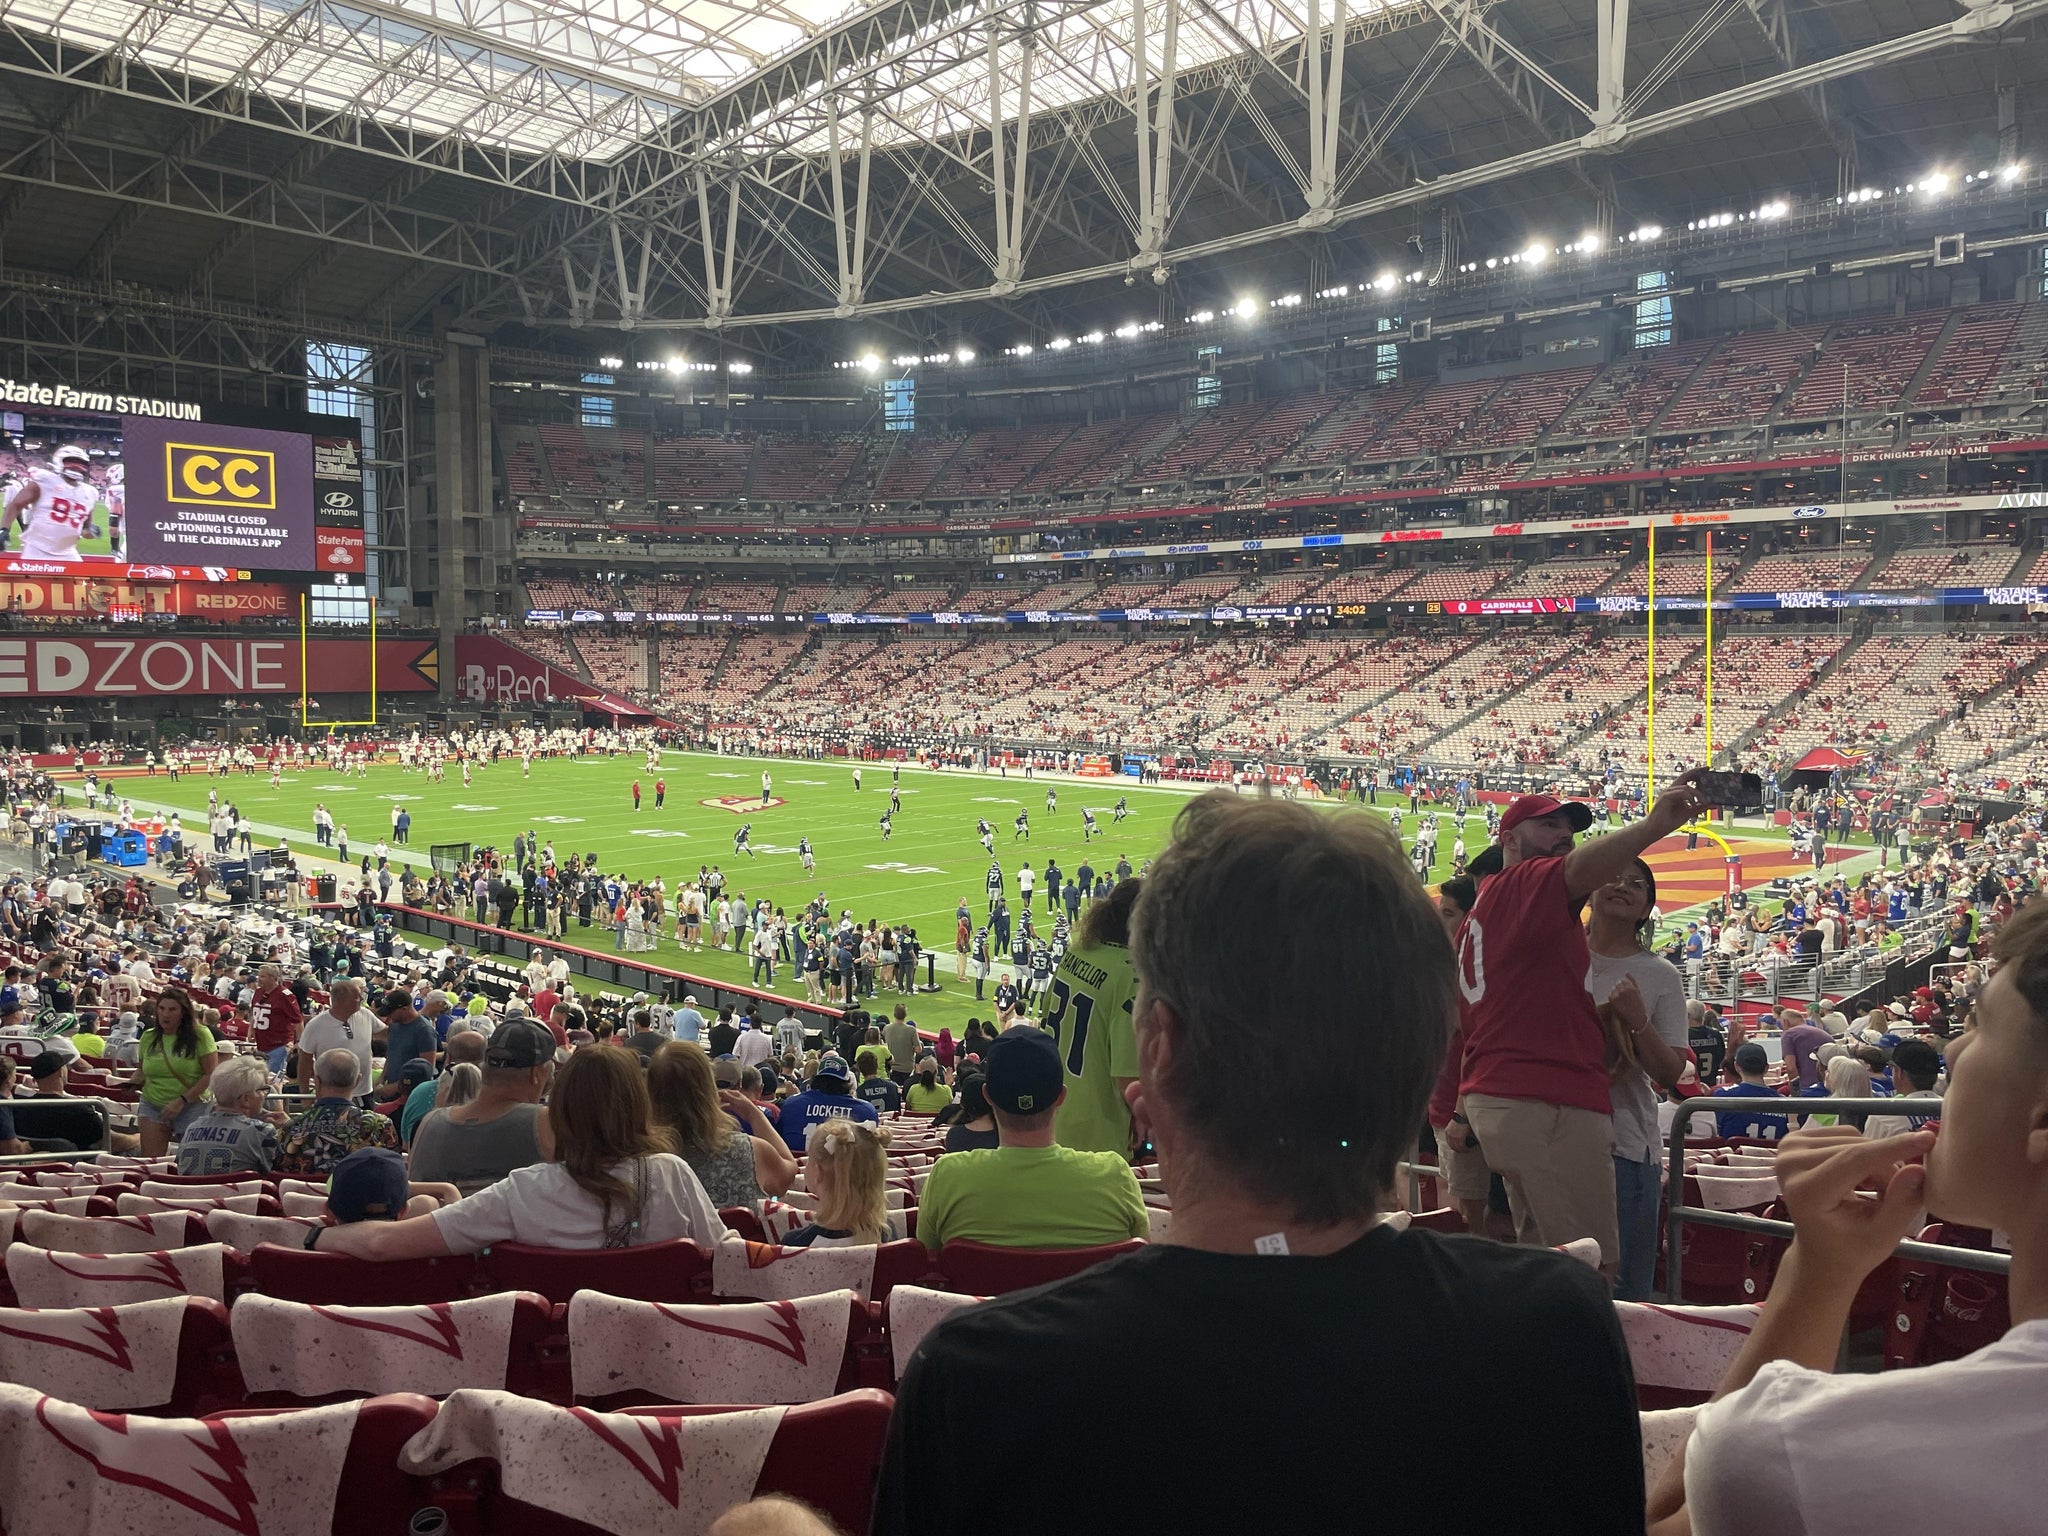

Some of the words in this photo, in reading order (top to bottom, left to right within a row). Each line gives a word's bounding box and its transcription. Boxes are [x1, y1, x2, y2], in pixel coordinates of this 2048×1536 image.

[116, 395, 201, 422] STADIUM
[1852, 453, 1877, 462] DICK
[1879, 451, 1916, 460] (NIGHT
[1920, 448, 1956, 457] TRAIN)
[1960, 445, 1989, 454] LANE
[183, 454, 260, 499] CC
[1443, 486, 1468, 494] LARRY
[1470, 484, 1500, 492] WILSON
[1997, 492, 2048, 508] AVN
[320, 507, 358, 517] HYUNDAI
[1798, 507, 1822, 517] Ford
[178, 511, 226, 523] STADIUM
[227, 514, 267, 526] CLOSED
[155, 521, 221, 534] CAPTIONING
[223, 525, 233, 534] IS
[235, 526, 289, 538] AVAILABLE
[163, 533, 176, 543] IN
[178, 534, 199, 544] THE
[200, 535, 259, 547] CARDINALS
[261, 539, 282, 548] APP
[1242, 540, 1263, 550] COX
[334, 572, 349, 585] 25
[1776, 591, 1823, 600] MUSTANG
[1983, 586, 2038, 597] MUSTANG
[51, 582, 171, 614] LIGHT
[1596, 596, 1636, 604] MUSTANG
[1781, 598, 1828, 608] MACH-E
[1832, 600, 1850, 608] SUV
[1988, 593, 2044, 605] MACH-E
[1246, 607, 1288, 615] SEAHAWKS
[1294, 606, 1301, 616] 0
[1336, 605, 1366, 615] 34:02
[1428, 604, 1439, 612] 25
[1458, 602, 1467, 613] 0
[1480, 601, 1534, 610] CARDINALS
[1600, 602, 1641, 611] MACH-E
[646, 613, 655, 621] S.
[656, 613, 699, 621] DARNOLD
[759, 614, 775, 622] 663
[797, 614, 804, 622] 4
[497, 665, 549, 703] Red
[277, 942, 290, 954] 85
[1032, 957, 1048, 969] 53
[1060, 950, 1108, 990] HANCELLOR
[865, 1086, 887, 1096] WILSON
[806, 1104, 852, 1119] LOCKETT
[186, 1127, 227, 1143] THOMAS
